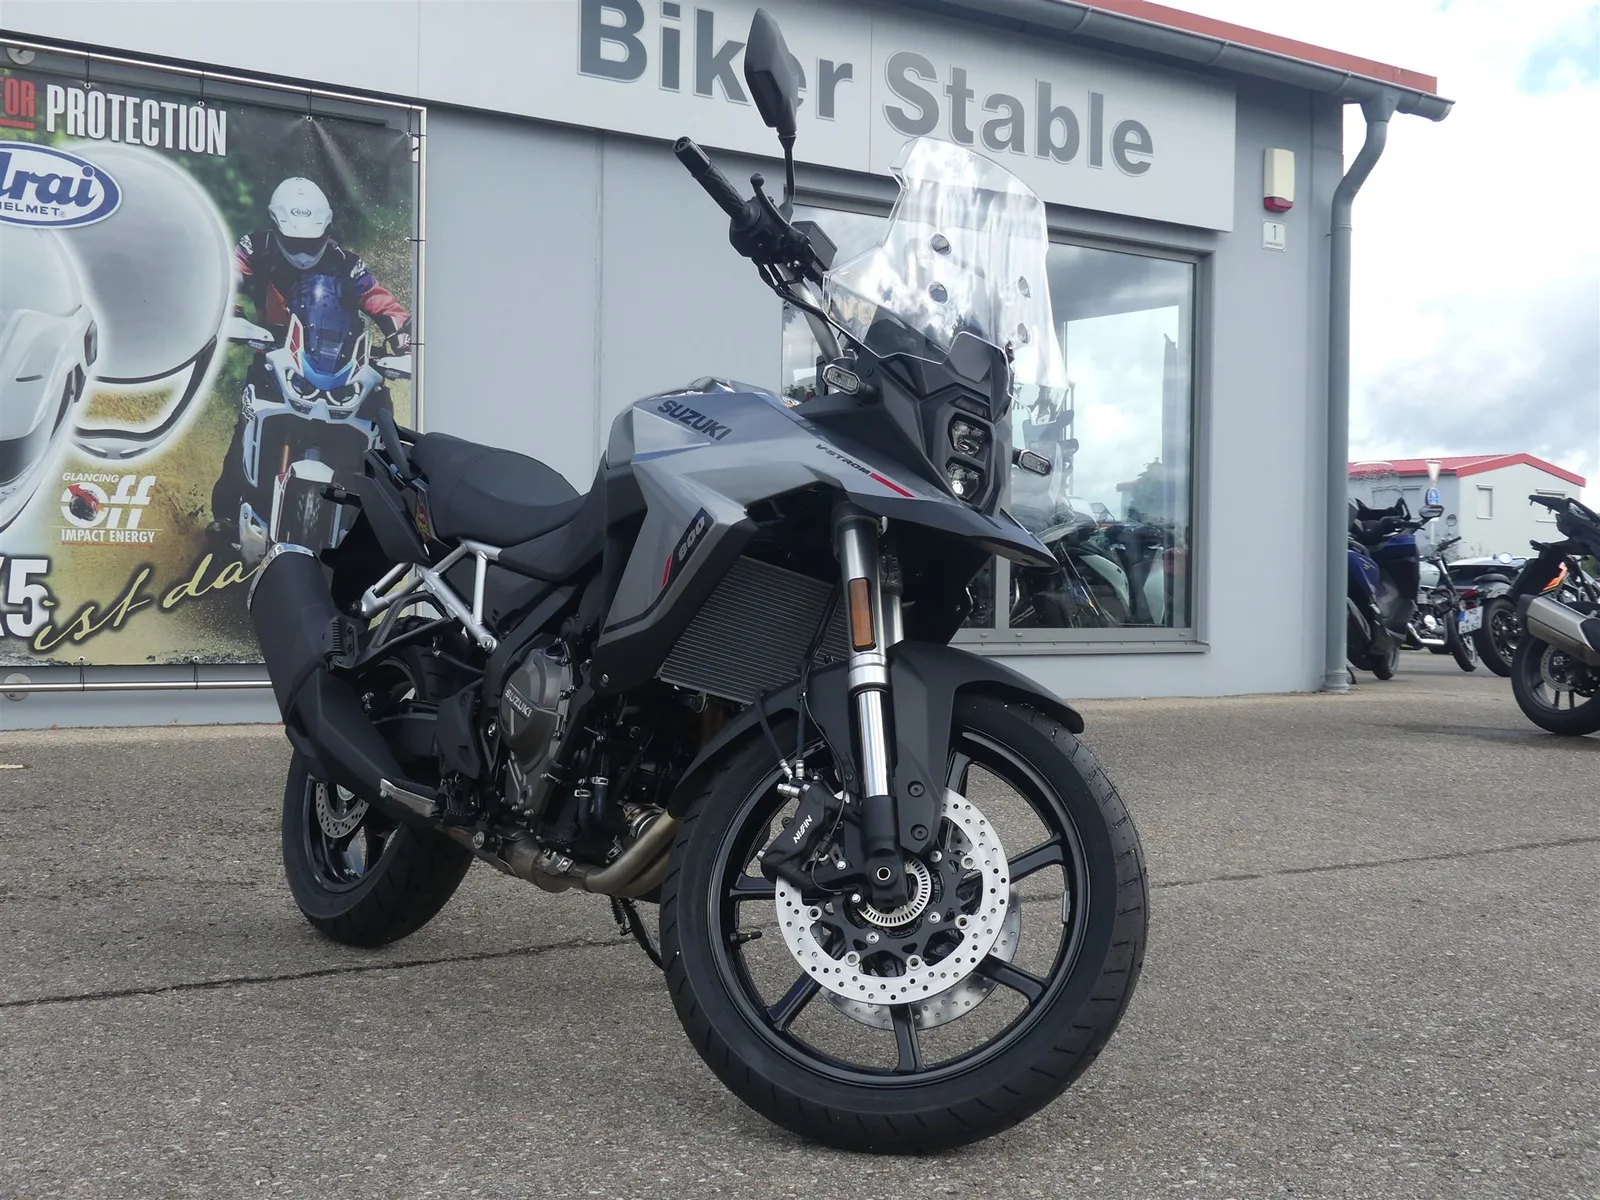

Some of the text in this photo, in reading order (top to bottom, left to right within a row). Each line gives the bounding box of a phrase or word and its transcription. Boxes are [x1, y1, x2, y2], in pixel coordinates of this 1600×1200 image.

[578, 0, 1155, 178] Bikr Stable
[46, 84, 227, 156] PROTECTION
[0, 201, 60, 216] ELMET
[1272, 224, 1278, 241] 1
[657, 400, 732, 441] SUZUKI
[62, 472, 120, 483] GLANCING
[61, 529, 155, 543] IMPACT ENERGY
[678, 516, 705, 562] 800
[0, 556, 50, 638] 5
[505, 689, 533, 718] SUZUKI
[793, 814, 812, 844] NISSIN
